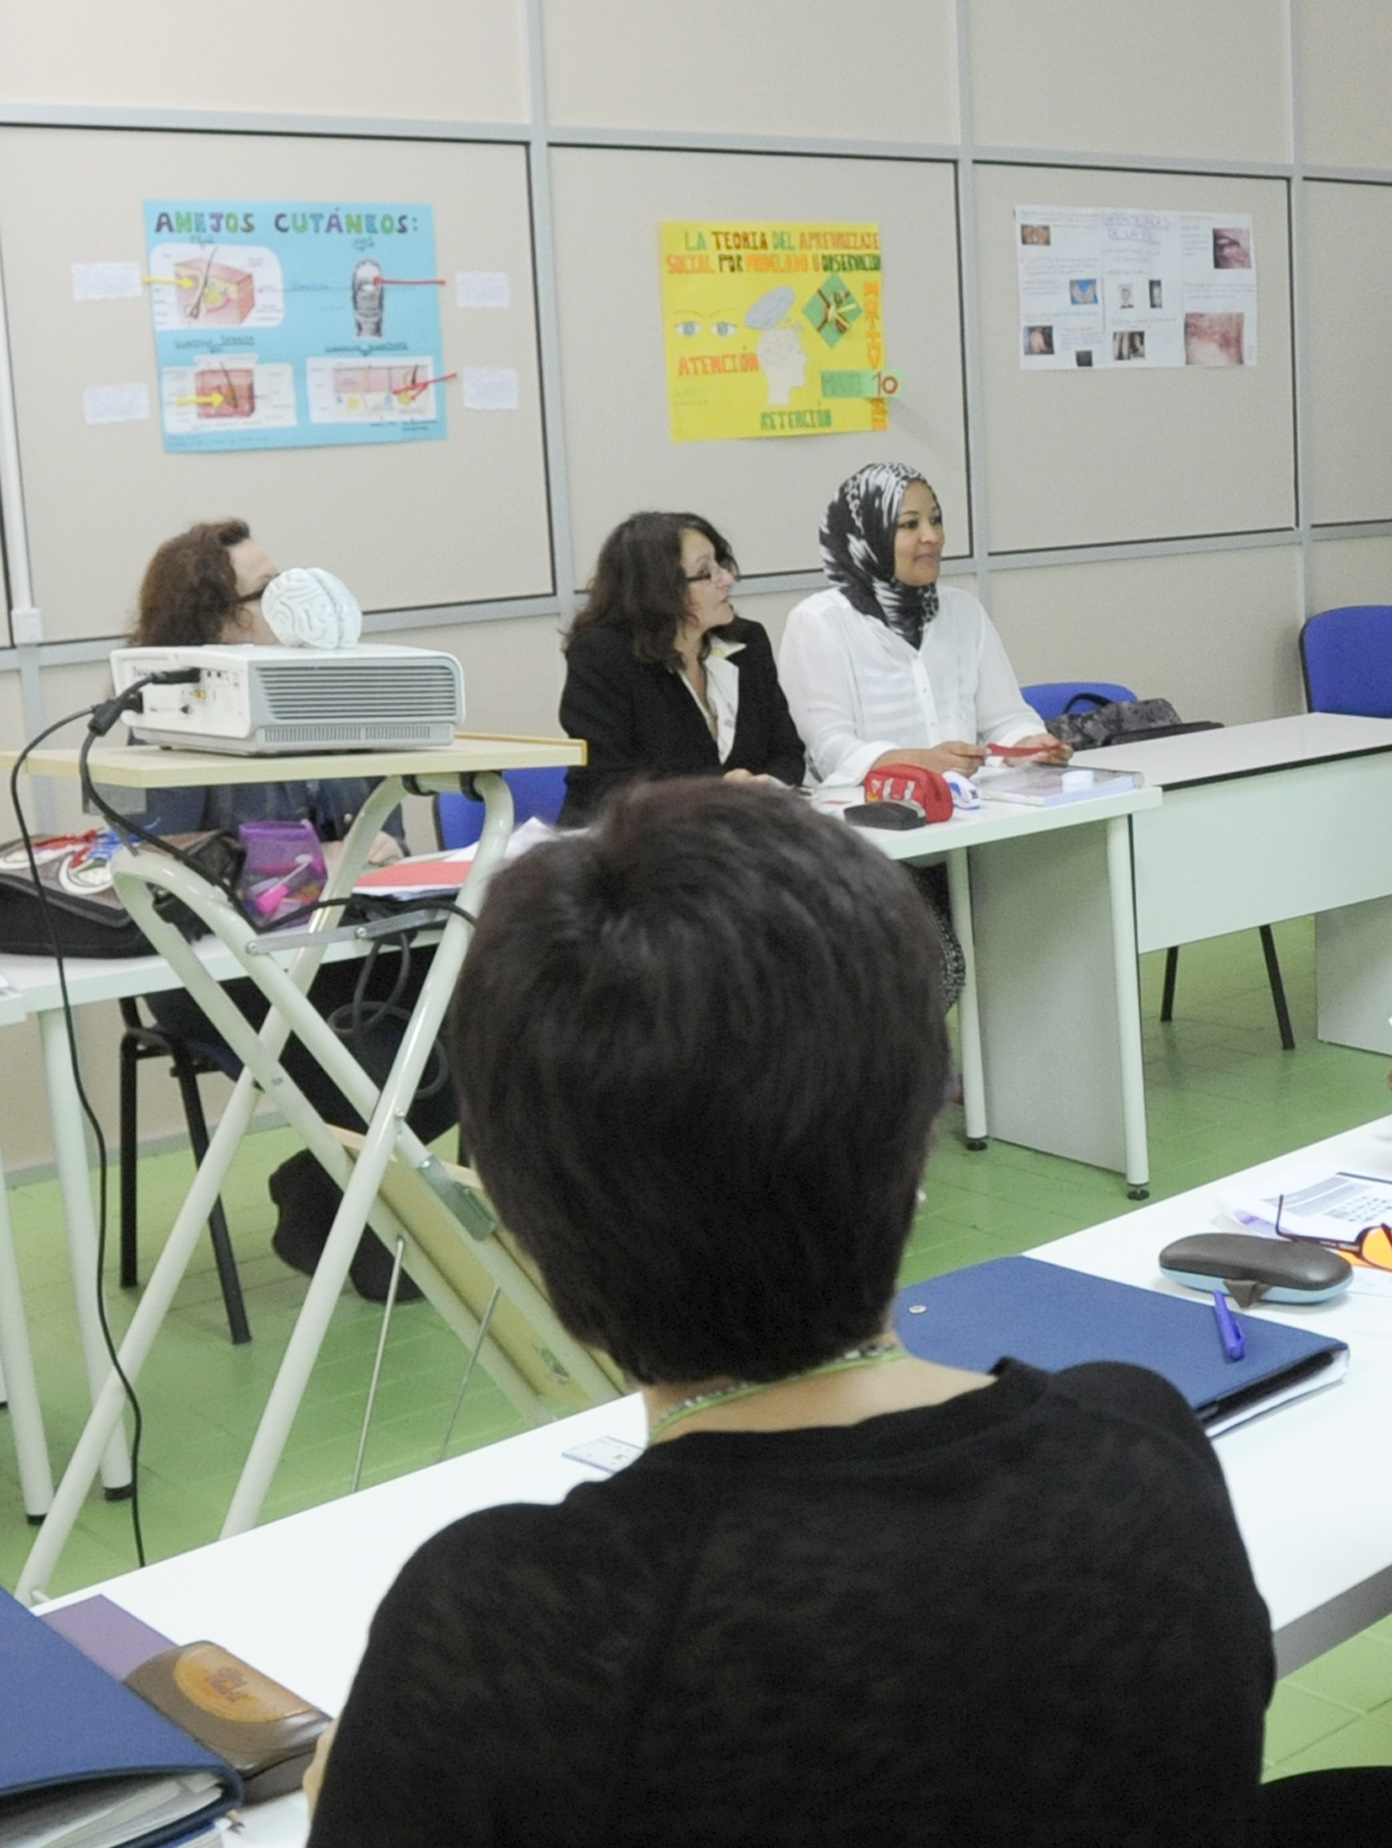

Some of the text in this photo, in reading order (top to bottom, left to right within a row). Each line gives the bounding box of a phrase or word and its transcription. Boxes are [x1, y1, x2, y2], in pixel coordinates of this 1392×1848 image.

[154, 206, 419, 234] ANEJOS CUTÁNEOS:
[684, 231, 708, 251] LA
[772, 230, 797, 251] DEL
[718, 253, 744, 273] POR
[678, 345, 759, 377] ATENCIÓN
[760, 401, 832, 431] RETENCIÓN
